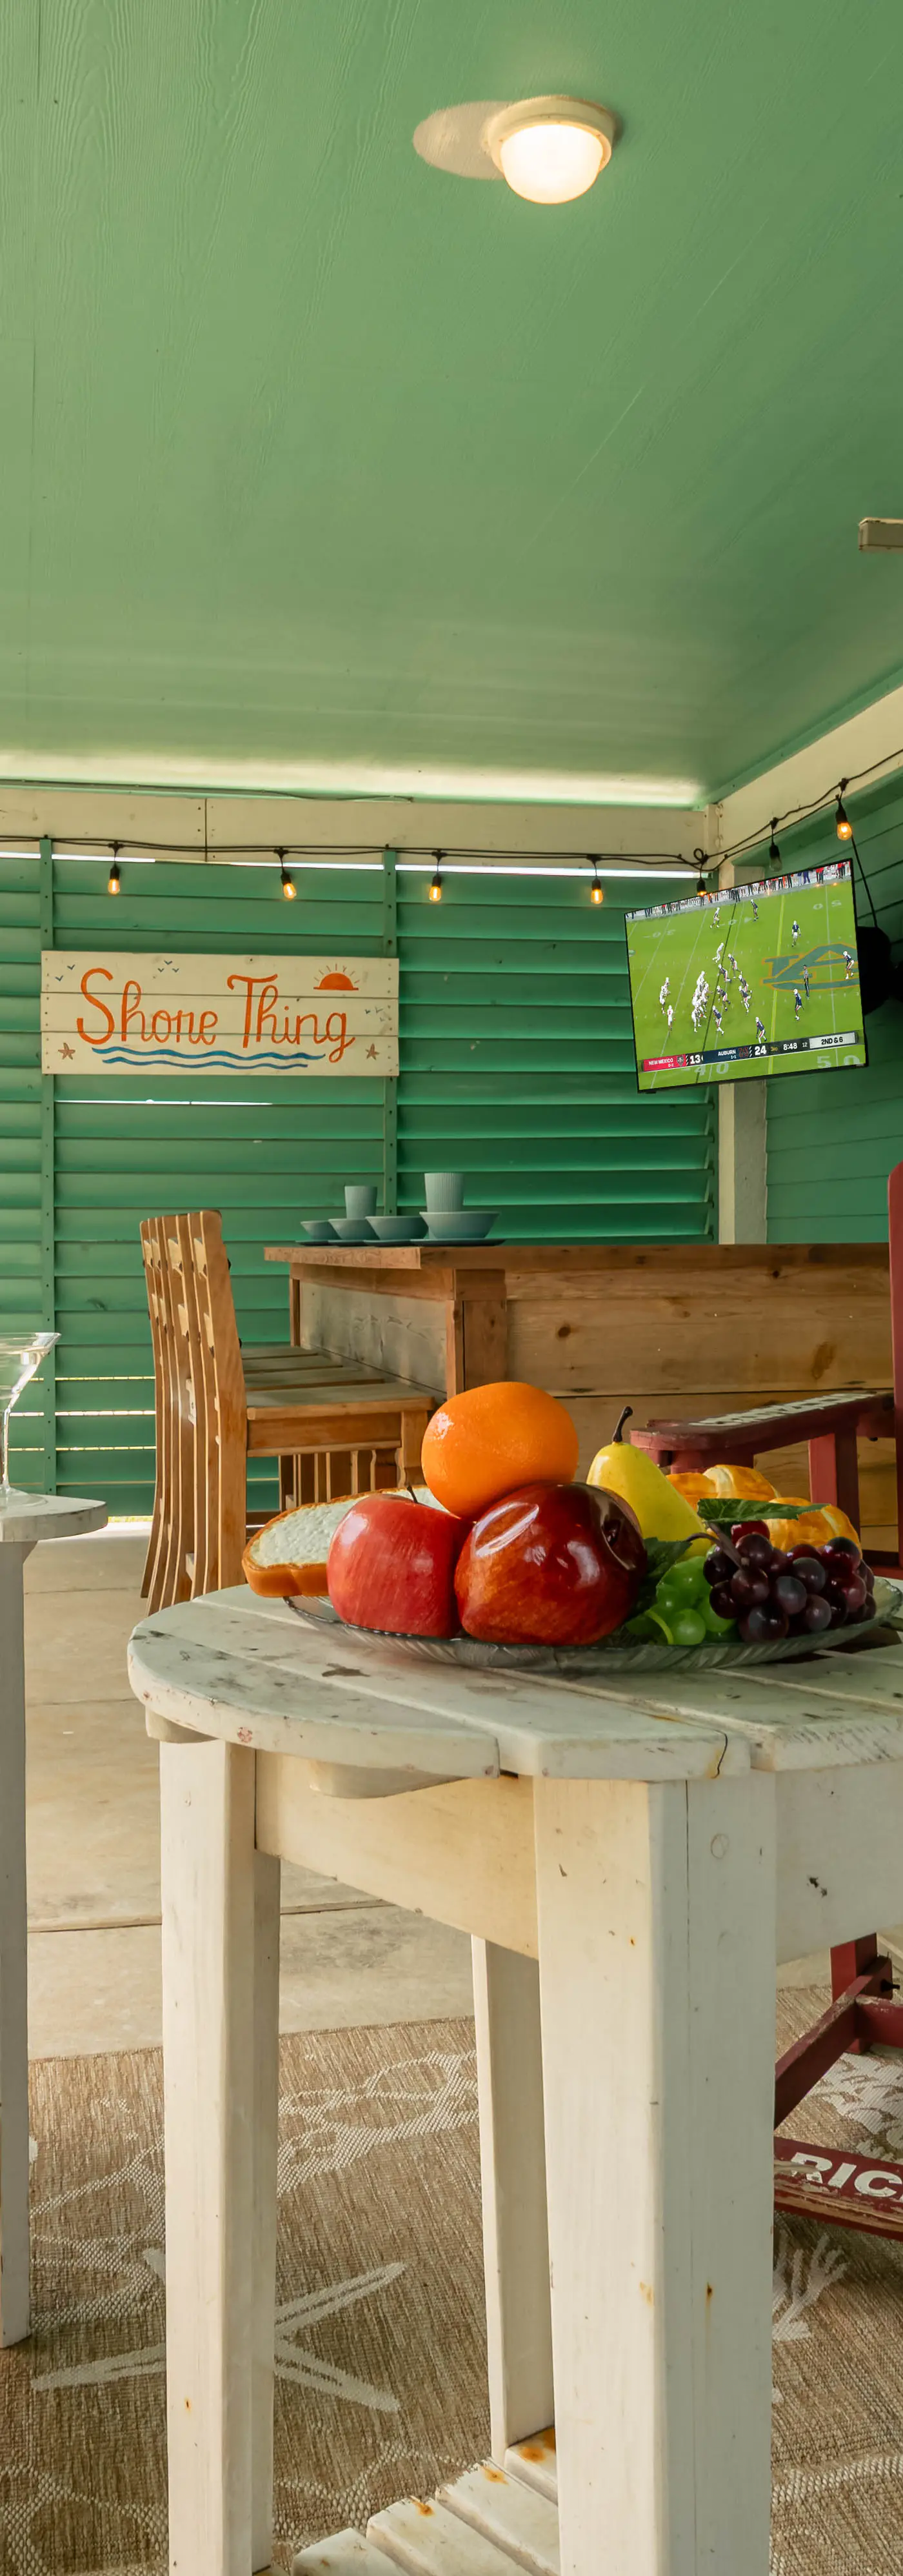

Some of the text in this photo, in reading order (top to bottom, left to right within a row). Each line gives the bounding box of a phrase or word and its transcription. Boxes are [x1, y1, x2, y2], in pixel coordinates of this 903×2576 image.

[76, 967, 355, 1063] Shore Thing
[755, 1045, 767, 1056] 24
[783, 1042, 798, 1051] 8:48
[690, 1054, 701, 1064] 13
[790, 2151, 903, 2202] RIC
